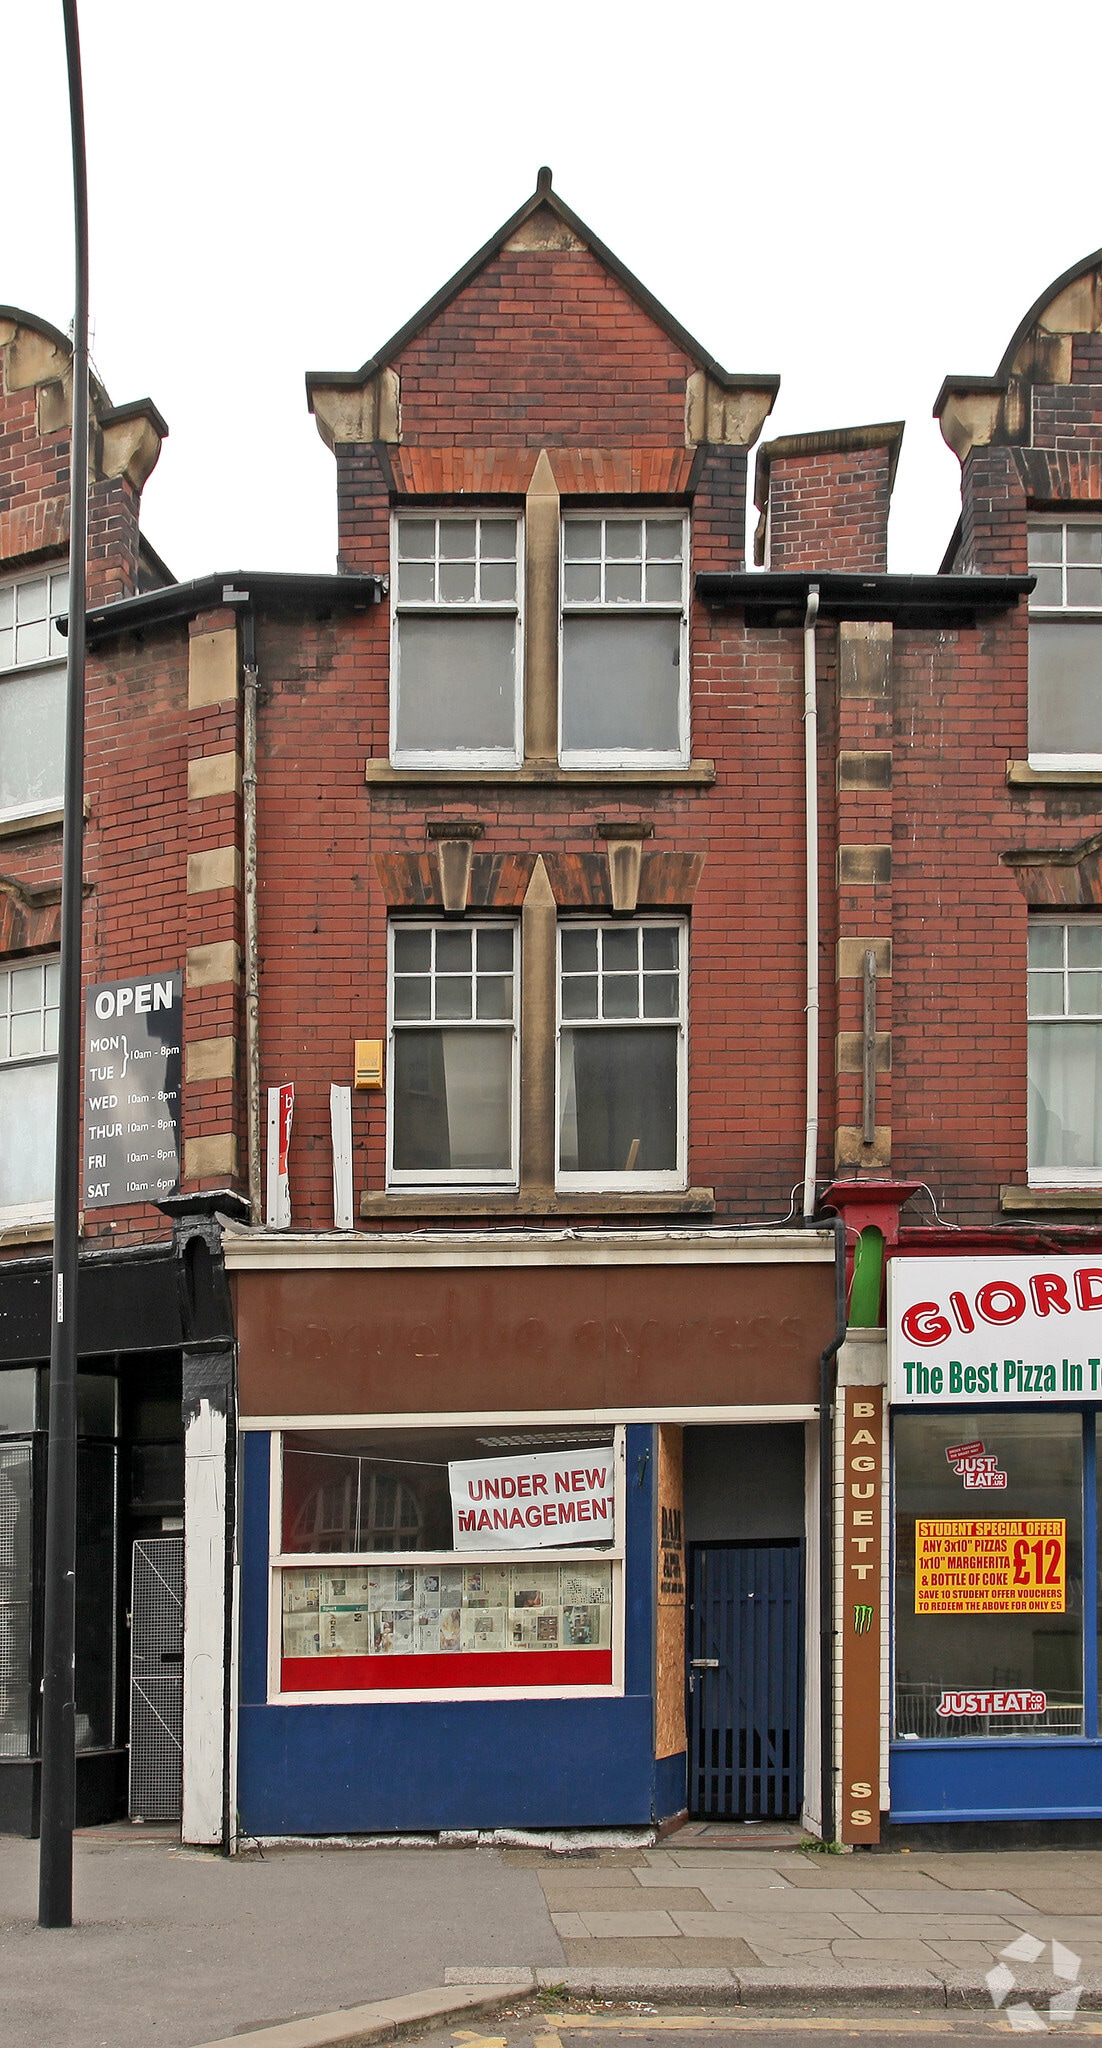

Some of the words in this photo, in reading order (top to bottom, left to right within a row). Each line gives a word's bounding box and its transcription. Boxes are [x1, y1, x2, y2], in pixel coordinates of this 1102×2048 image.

[95, 980, 173, 1019] OPEN
[90, 1036, 119, 1053] MON
[130, 1049, 152, 1060] 10am
[161, 1045, 180, 1059] 8pm
[90, 1068, 114, 1082] TUE
[89, 1096, 118, 1111] WED
[127, 1094, 149, 1104] 10am
[157, 1090, 177, 1103] 8pm
[89, 1124, 123, 1140] THUR
[127, 1122, 149, 1133] 10am
[157, 1119, 177, 1132] 8pm
[88, 1154, 106, 1169] FRI
[127, 1152, 148, 1163] 10am
[157, 1149, 176, 1162] 8pm
[88, 1183, 110, 1199] SAT
[126, 1181, 148, 1192] 10am
[157, 1179, 176, 1191] 6pm
[901, 1268, 1102, 1347] GIORD
[903, 1362, 943, 1394] The
[949, 1361, 998, 1394] Best
[1003, 1359, 1056, 1393] Pizza
[1062, 1359, 1083, 1391] In
[1088, 1358, 1102, 1391] T
[956, 1458, 995, 1472] JUST
[468, 1474, 548, 1502] UNDER
[555, 1467, 607, 1493] NEW
[966, 1473, 994, 1486] EAT
[850, 1402, 876, 1580] BAGUETT
[458, 1496, 614, 1532] MANAGEMENT
[920, 1522, 974, 1536] STUDENT
[975, 1522, 1024, 1536] SPECIAL
[1026, 1522, 1061, 1535] OFFER
[923, 1540, 942, 1552] ANY
[974, 1539, 1007, 1552] PIZZAS
[947, 1556, 1010, 1569] MARGHERITA
[1013, 1539, 1061, 1585] £12
[921, 1576, 929, 1586] &
[931, 1573, 966, 1586] BOTTLE
[968, 1573, 981, 1586] OF
[982, 1572, 1008, 1585] COKE
[918, 1590, 939, 1599] SAVE
[941, 1590, 951, 1599] 10
[952, 1590, 989, 1599] STUDENT
[991, 1590, 1016, 1599] OFFER
[1017, 1589, 1062, 1598] VOUCHERS
[918, 1602, 929, 1611] TO
[931, 1602, 963, 1611] REDEEM
[965, 1602, 981, 1611] THE
[982, 1602, 1009, 1610] ABOVE
[1011, 1602, 1027, 1610] FOR
[1028, 1601, 1048, 1610] ONLY
[1050, 1600, 1062, 1610] £5
[941, 1695, 991, 1713] JUST
[993, 1694, 1030, 1711] EAT
